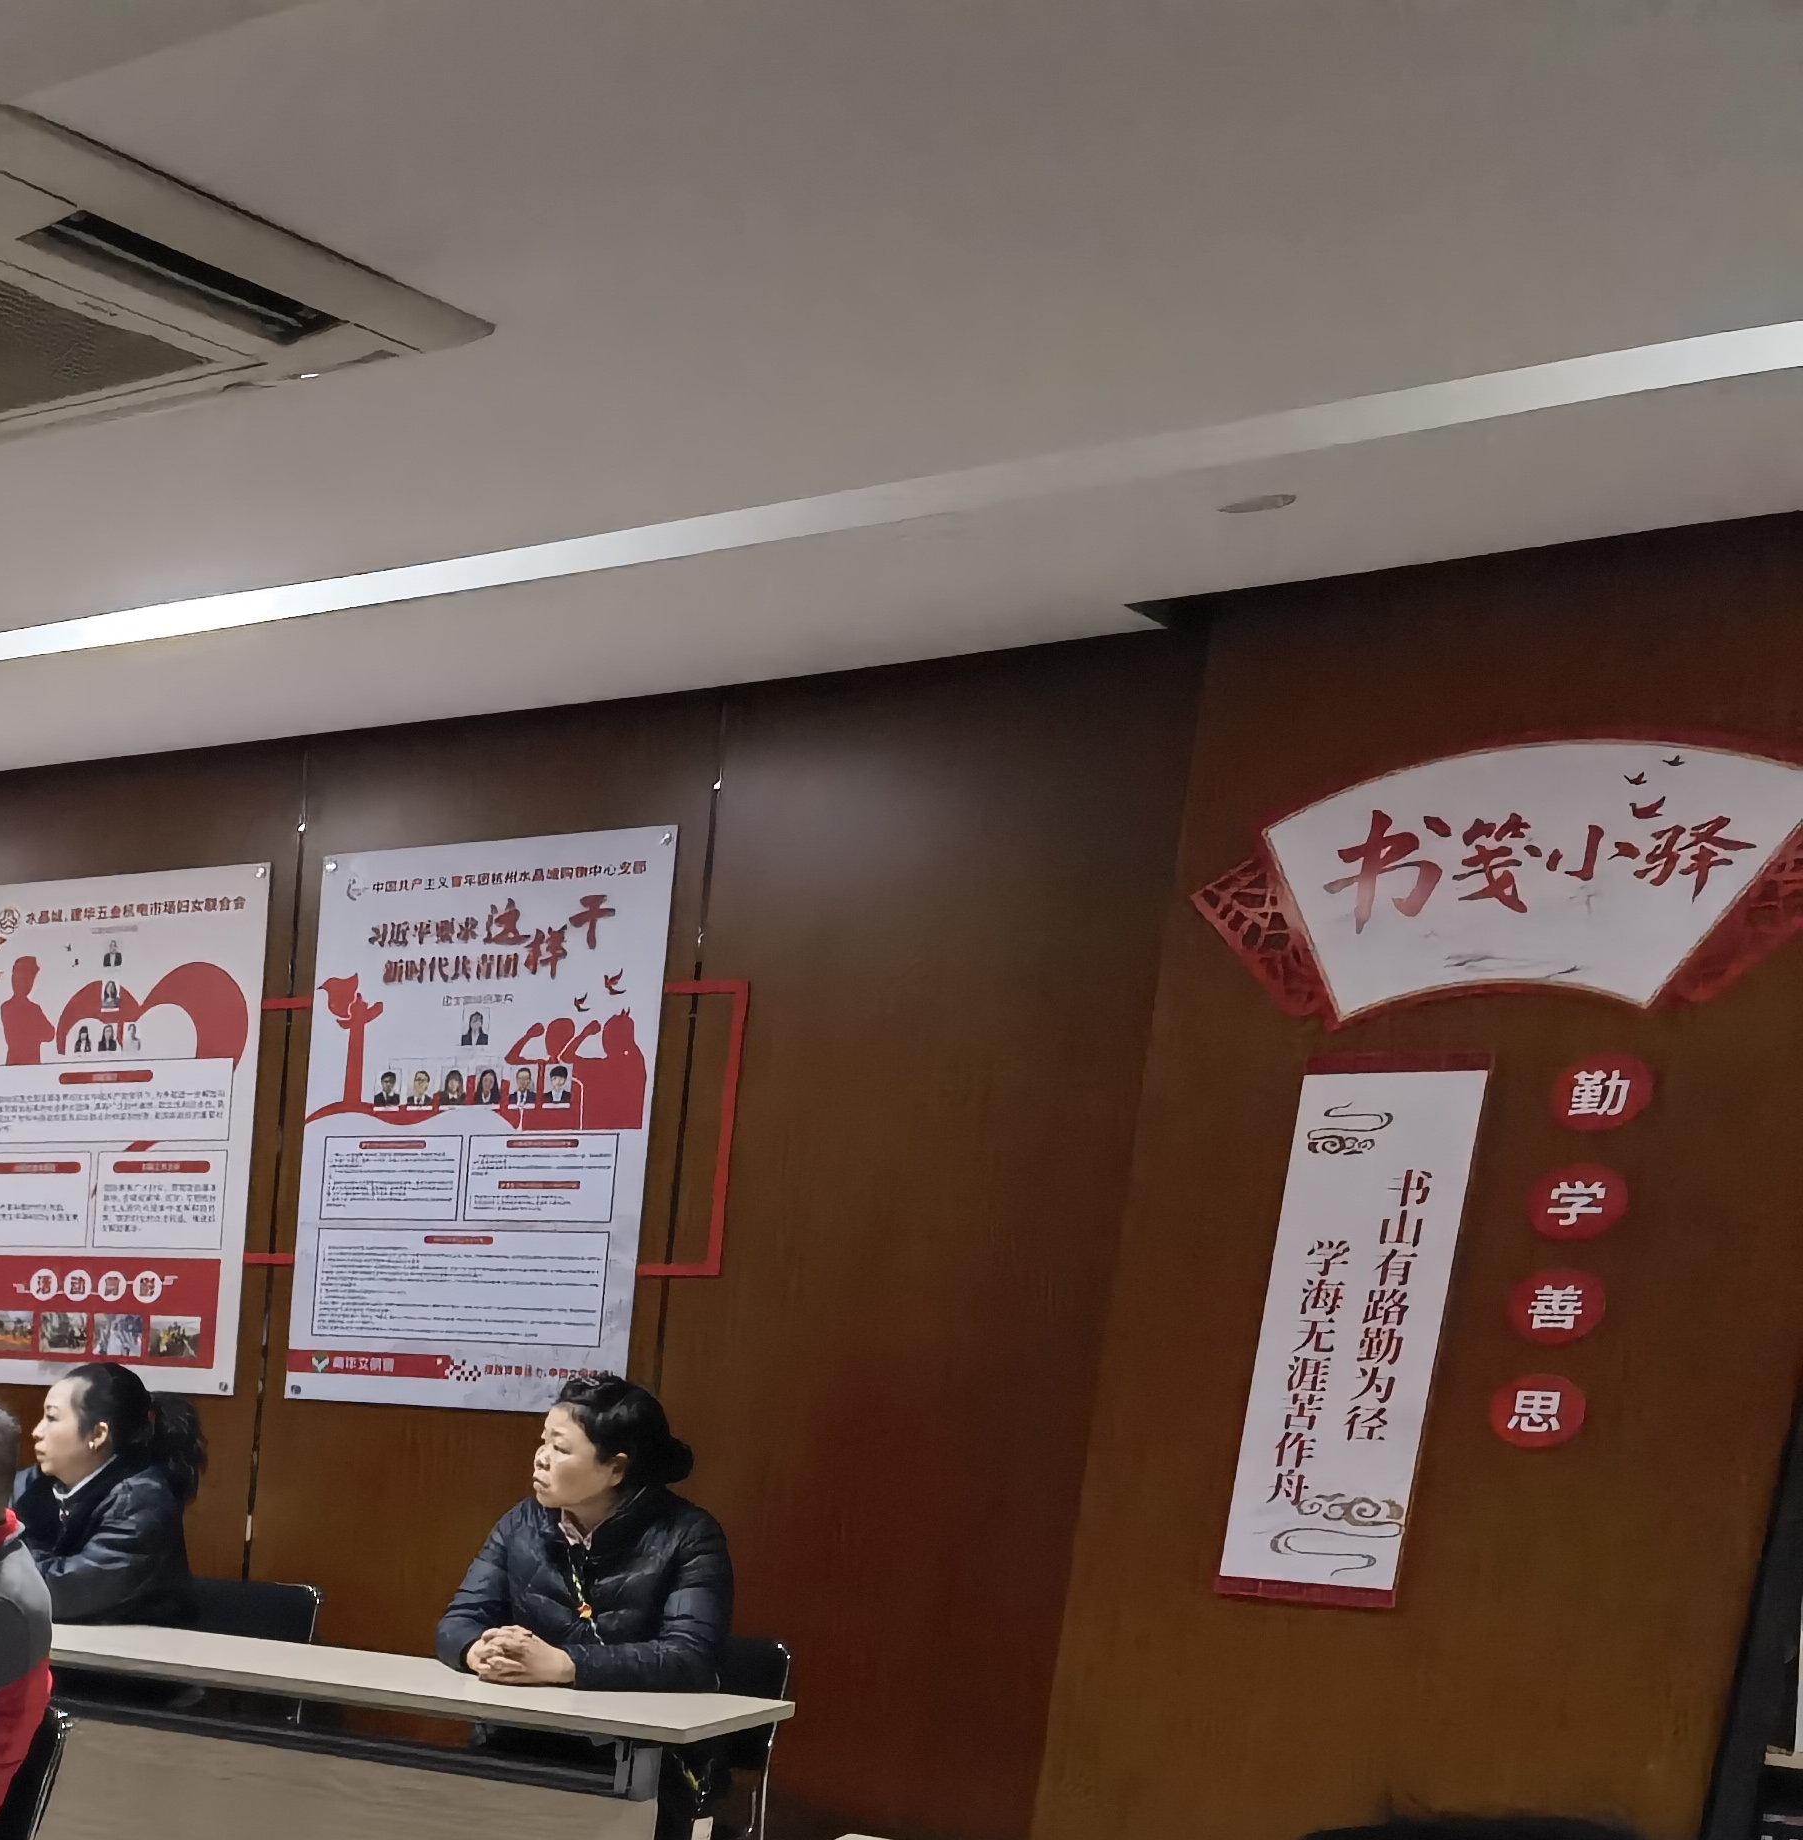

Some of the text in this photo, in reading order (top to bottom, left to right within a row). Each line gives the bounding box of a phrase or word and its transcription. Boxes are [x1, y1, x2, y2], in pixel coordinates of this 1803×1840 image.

[1323, 808, 1757, 935] 书笺小驿
[1266, 1239, 1351, 1507] 学海无涯苦作舟
[1343, 1168, 1433, 1443] 书山有路勤为径
